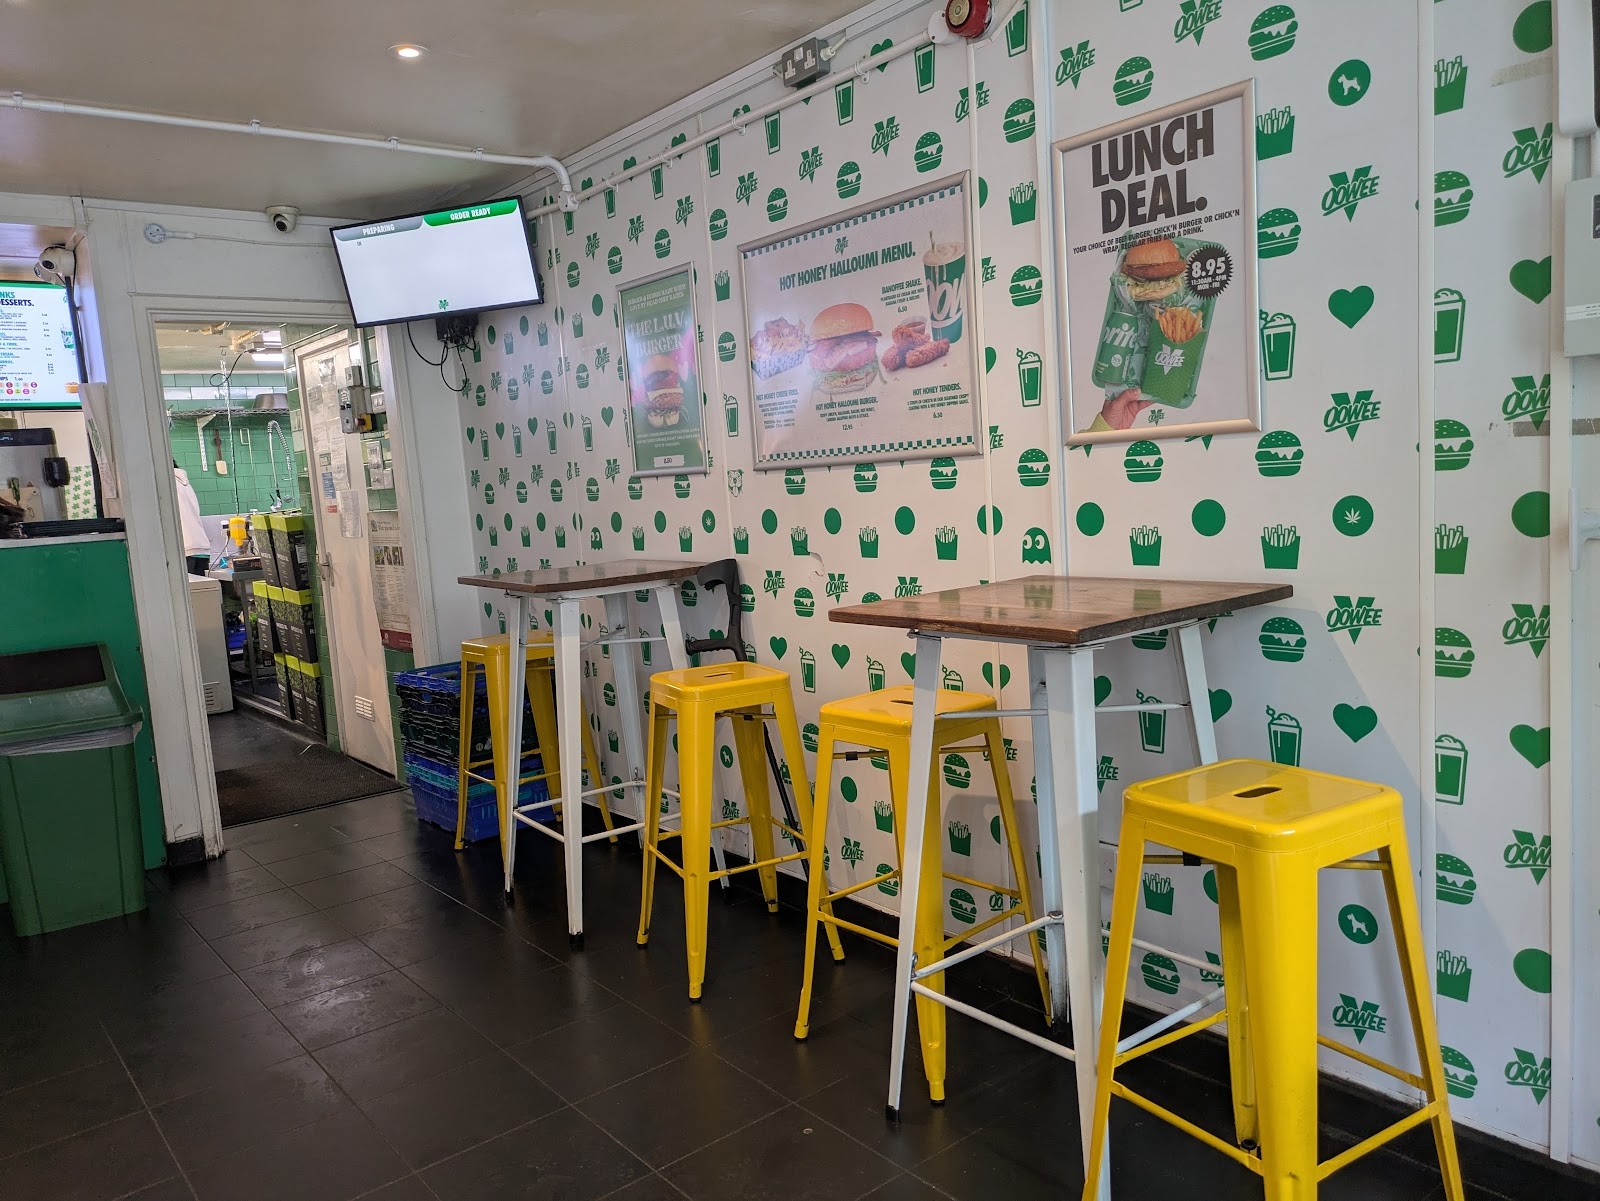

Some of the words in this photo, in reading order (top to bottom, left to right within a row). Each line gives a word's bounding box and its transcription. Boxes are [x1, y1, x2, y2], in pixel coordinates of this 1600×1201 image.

[1092, 108, 1214, 188] LUNCH
[1101, 169, 1207, 234] DEAL.
[1321, 176, 1380, 211] OOWEE
[450, 209, 470, 221] ORDER
[471, 206, 491, 218] READY
[362, 223, 395, 236] PREPARING
[1073, 245, 1087, 255] YOUR
[1088, 240, 1106, 251] CHOICE
[1106, 238, 1114, 246] OF
[1115, 235, 1127, 244] BEEF
[1154, 224, 1177, 235] CHICK'N
[1179, 218, 1202, 229] BURGER
[1204, 215, 1213, 223] OR
[1214, 209, 1240, 220] CHICK'N
[1121, 239, 1146, 250] REGULAR
[1147, 235, 1162, 245] FRIES
[1163, 232, 1176, 240] AND
[1183, 226, 1203, 236] DRINK.
[779, 274, 796, 291] HOT
[798, 264, 827, 285] HONEY
[829, 251, 879, 278] HALLOUMI
[881, 241, 916, 265] MENU.
[1192, 257, 1225, 278] 8.95
[882, 282, 904, 294] BANOFFEE
[905, 277, 922, 288] SHAKE.
[1215, 274, 1227, 282] 4PM
[1155, 351, 1185, 366] OOWEE
[912, 388, 922, 396] HOT
[922, 386, 938, 395] HONEY
[939, 383, 962, 392] TENDERS.
[823, 401, 837, 410] HONEY
[837, 398, 859, 408] HALLOUMI
[1323, 400, 1382, 428] OOWEE
[763, 577, 786, 590] OOWEE
[825, 581, 849, 594] OOWEE
[1326, 606, 1383, 628] OOWEE
[1332, 1005, 1387, 1031] OOWEE
